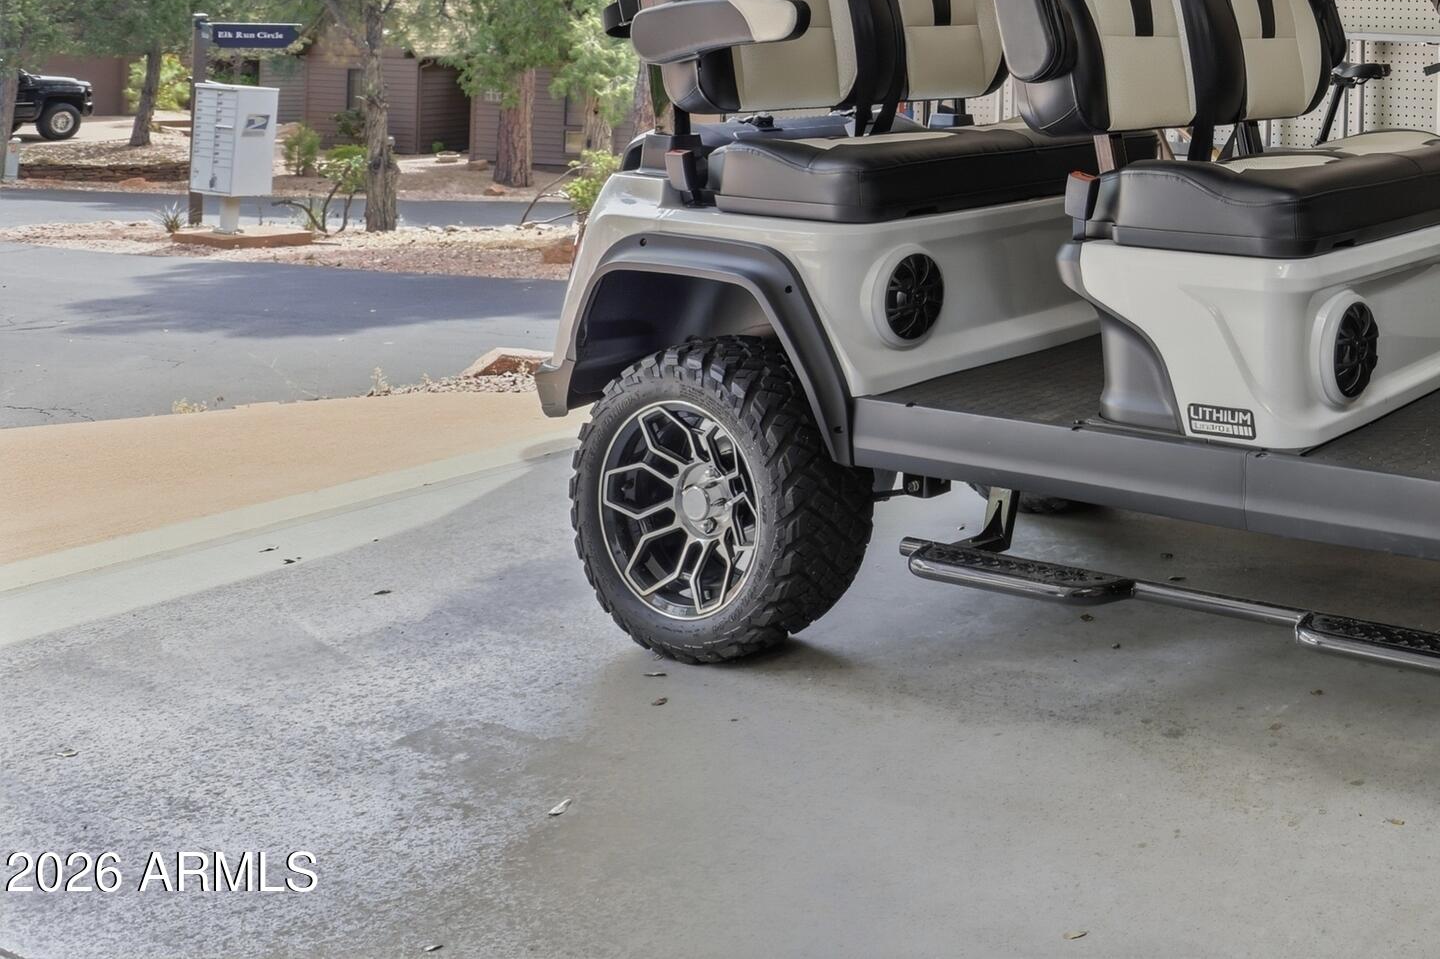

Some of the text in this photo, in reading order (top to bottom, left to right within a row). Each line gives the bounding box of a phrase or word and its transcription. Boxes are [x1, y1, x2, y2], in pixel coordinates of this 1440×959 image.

[235, 31, 255, 39] Run
[256, 31, 284, 39] Circle
[1190, 406, 1251, 424] LITHIUM
